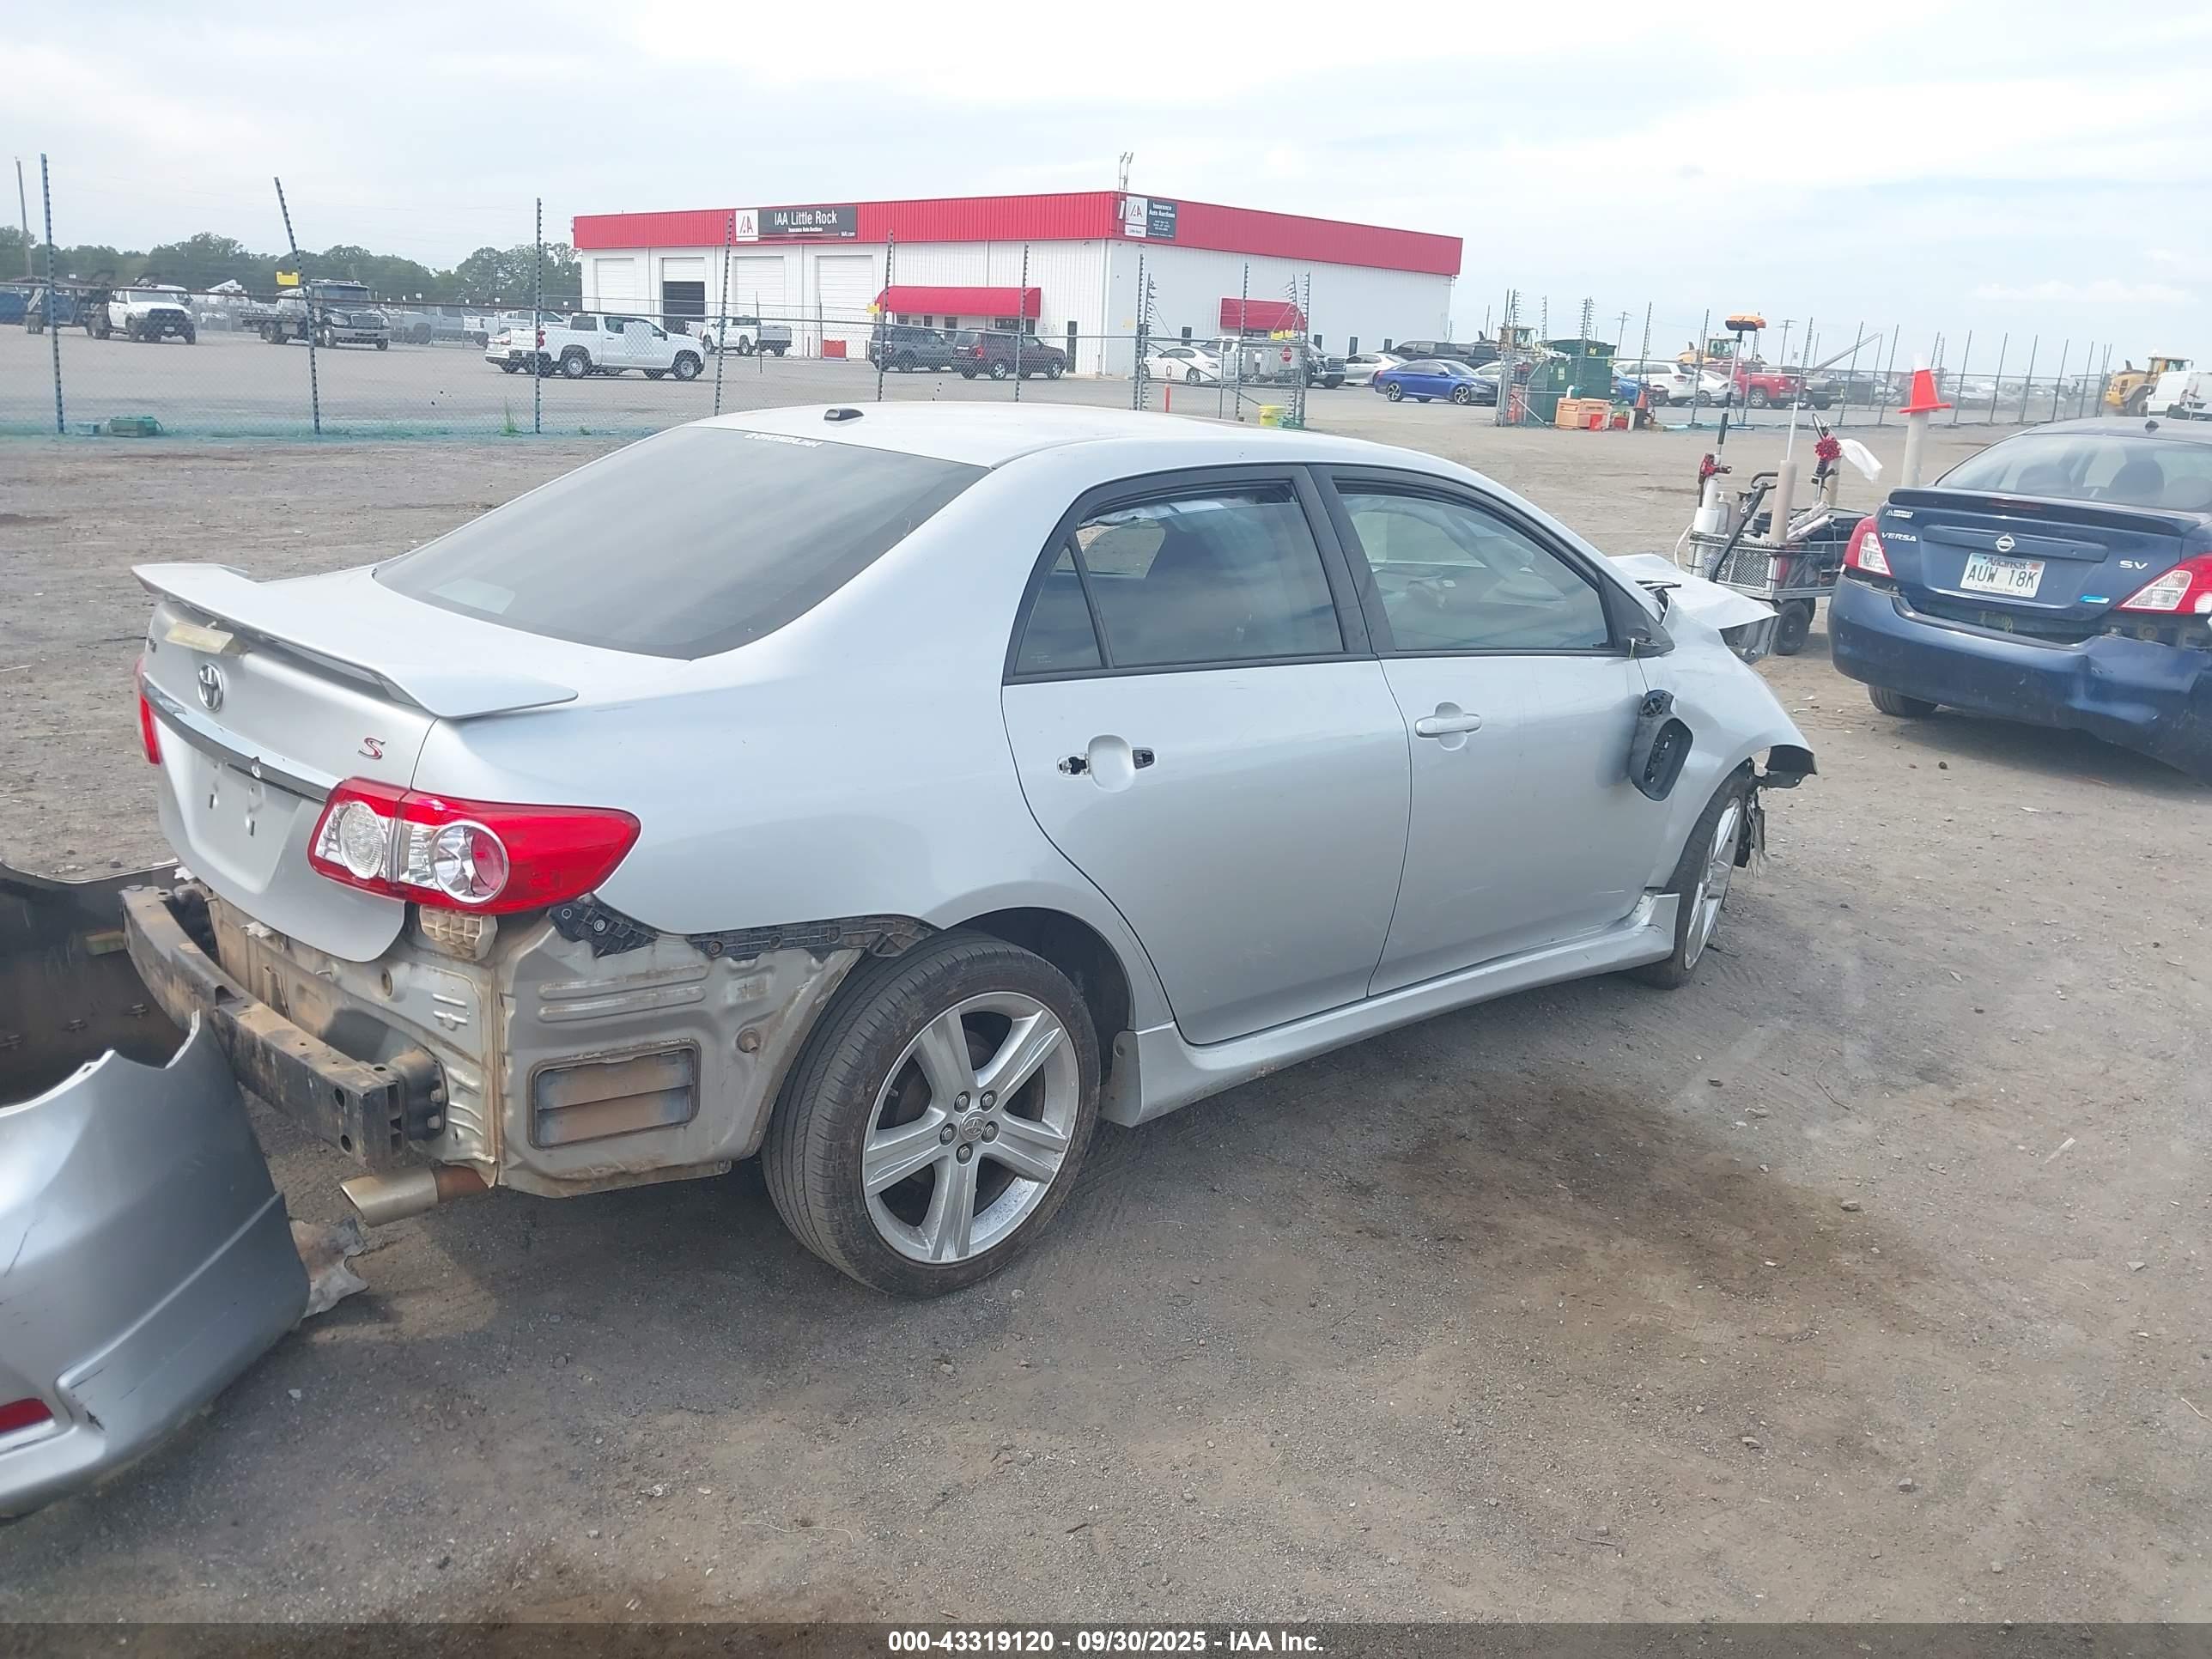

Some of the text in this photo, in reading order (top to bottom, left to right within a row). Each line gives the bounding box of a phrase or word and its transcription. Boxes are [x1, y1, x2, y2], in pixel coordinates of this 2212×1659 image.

[775, 210, 838, 226] IAA Little Rock
[1881, 532, 1917, 542] VERSA
[1985, 556, 2027, 570] Arkansas
[2119, 560, 2148, 570] SV
[1966, 565, 2038, 588] AUW 18K
[357, 737, 386, 760] S
